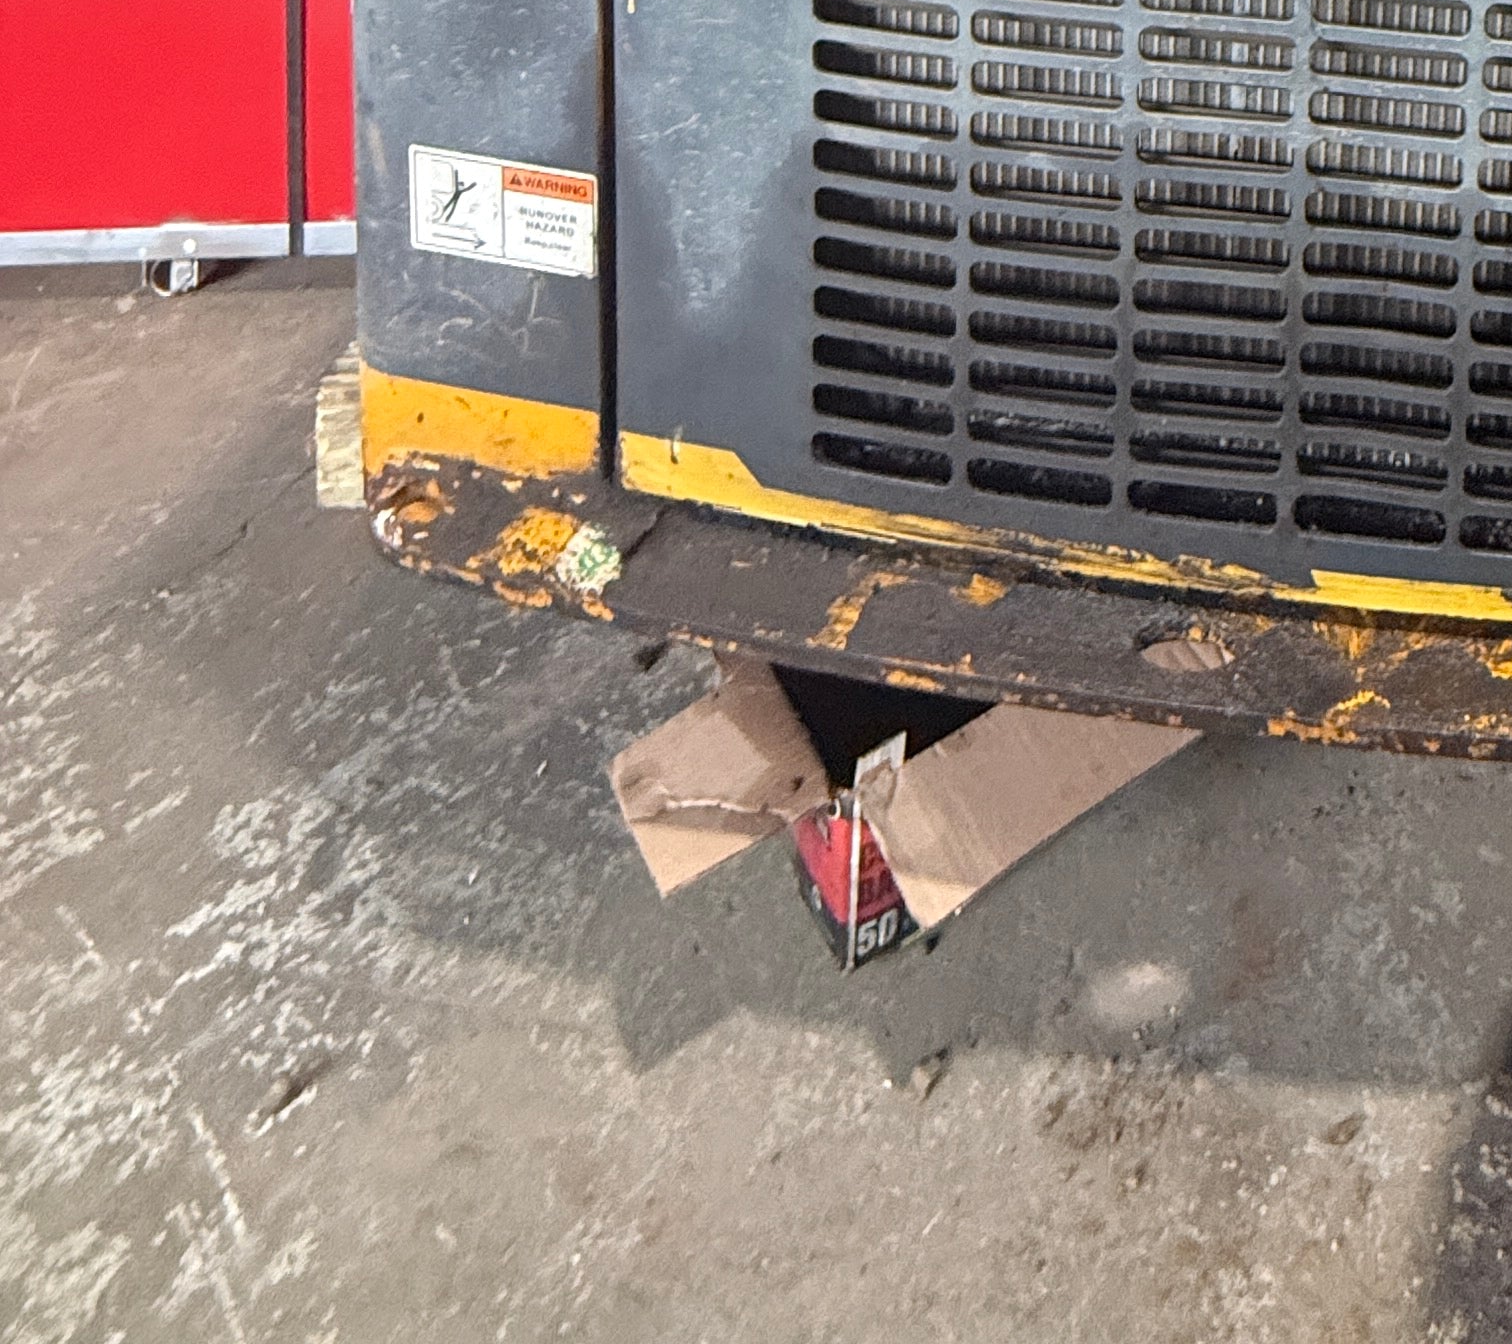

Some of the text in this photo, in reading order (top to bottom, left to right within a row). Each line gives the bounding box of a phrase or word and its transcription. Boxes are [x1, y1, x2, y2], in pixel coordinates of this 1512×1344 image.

[523, 176, 588, 198] WARNING
[519, 206, 578, 224] RUNOVER
[526, 220, 575, 238] HAZARD
